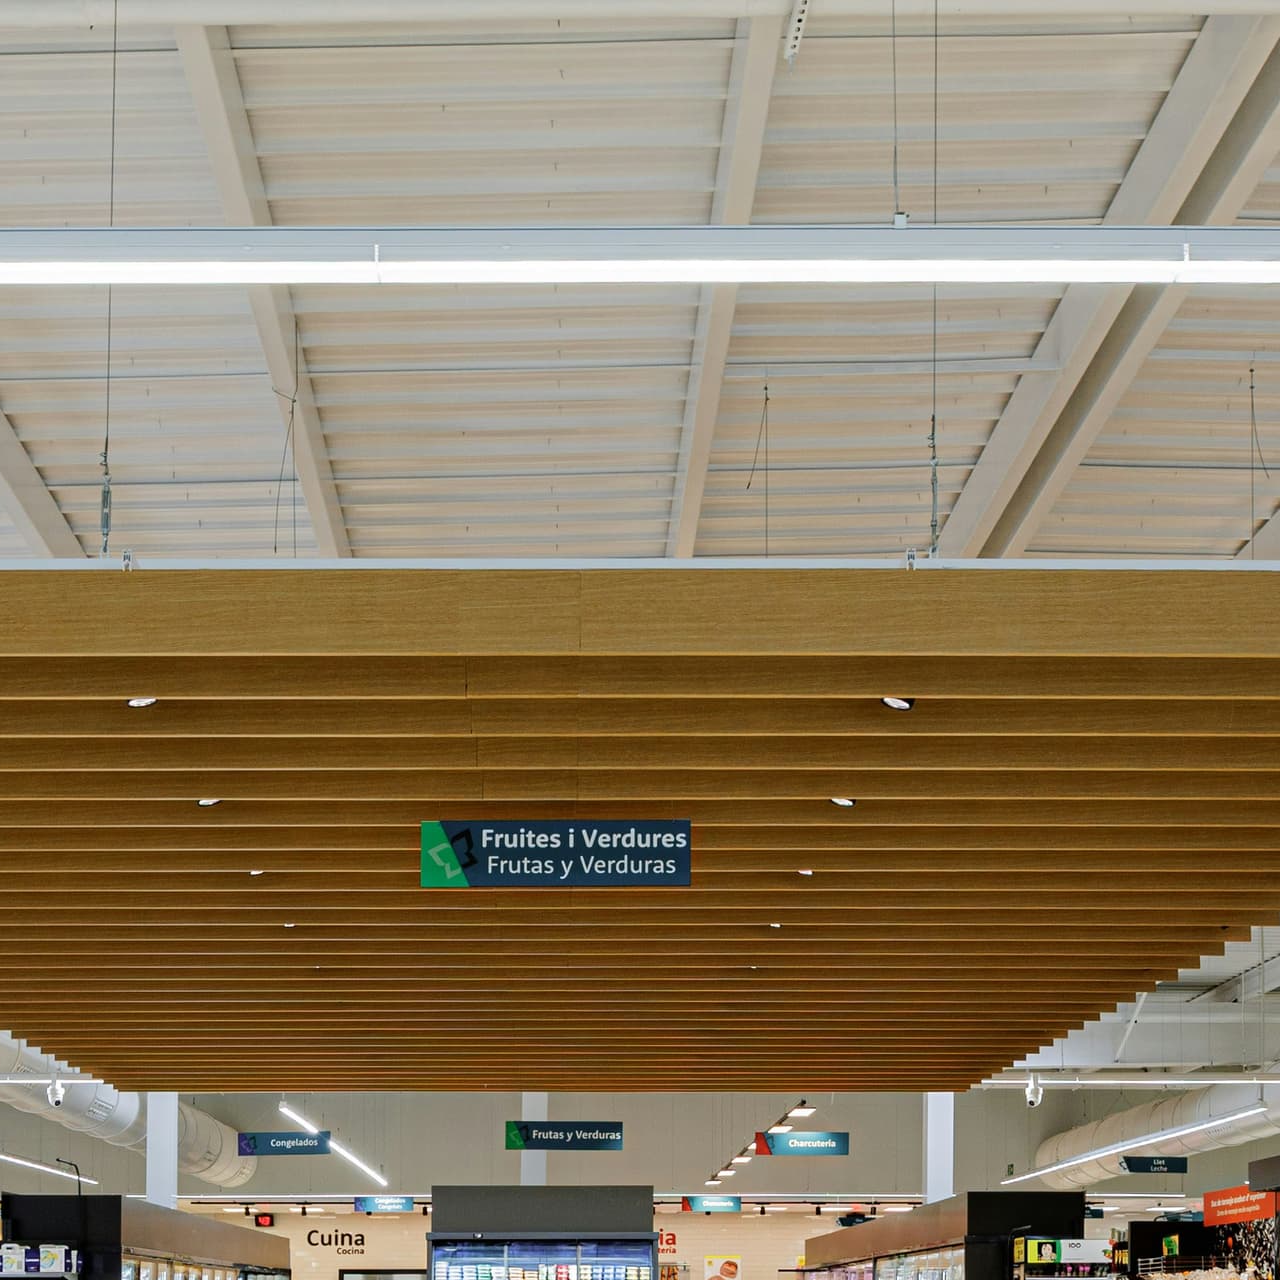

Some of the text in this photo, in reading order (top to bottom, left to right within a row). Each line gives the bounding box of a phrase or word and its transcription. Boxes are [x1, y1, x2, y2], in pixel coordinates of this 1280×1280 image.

[481, 828, 687, 848] Fruites i Verdures
[488, 855, 676, 879] Frutas y Verduras
[270, 1137, 319, 1148] Congelados
[532, 1129, 622, 1142] Frutas y Verduras
[307, 1229, 365, 1247] Cuina
[336, 1247, 365, 1255] Cocina
